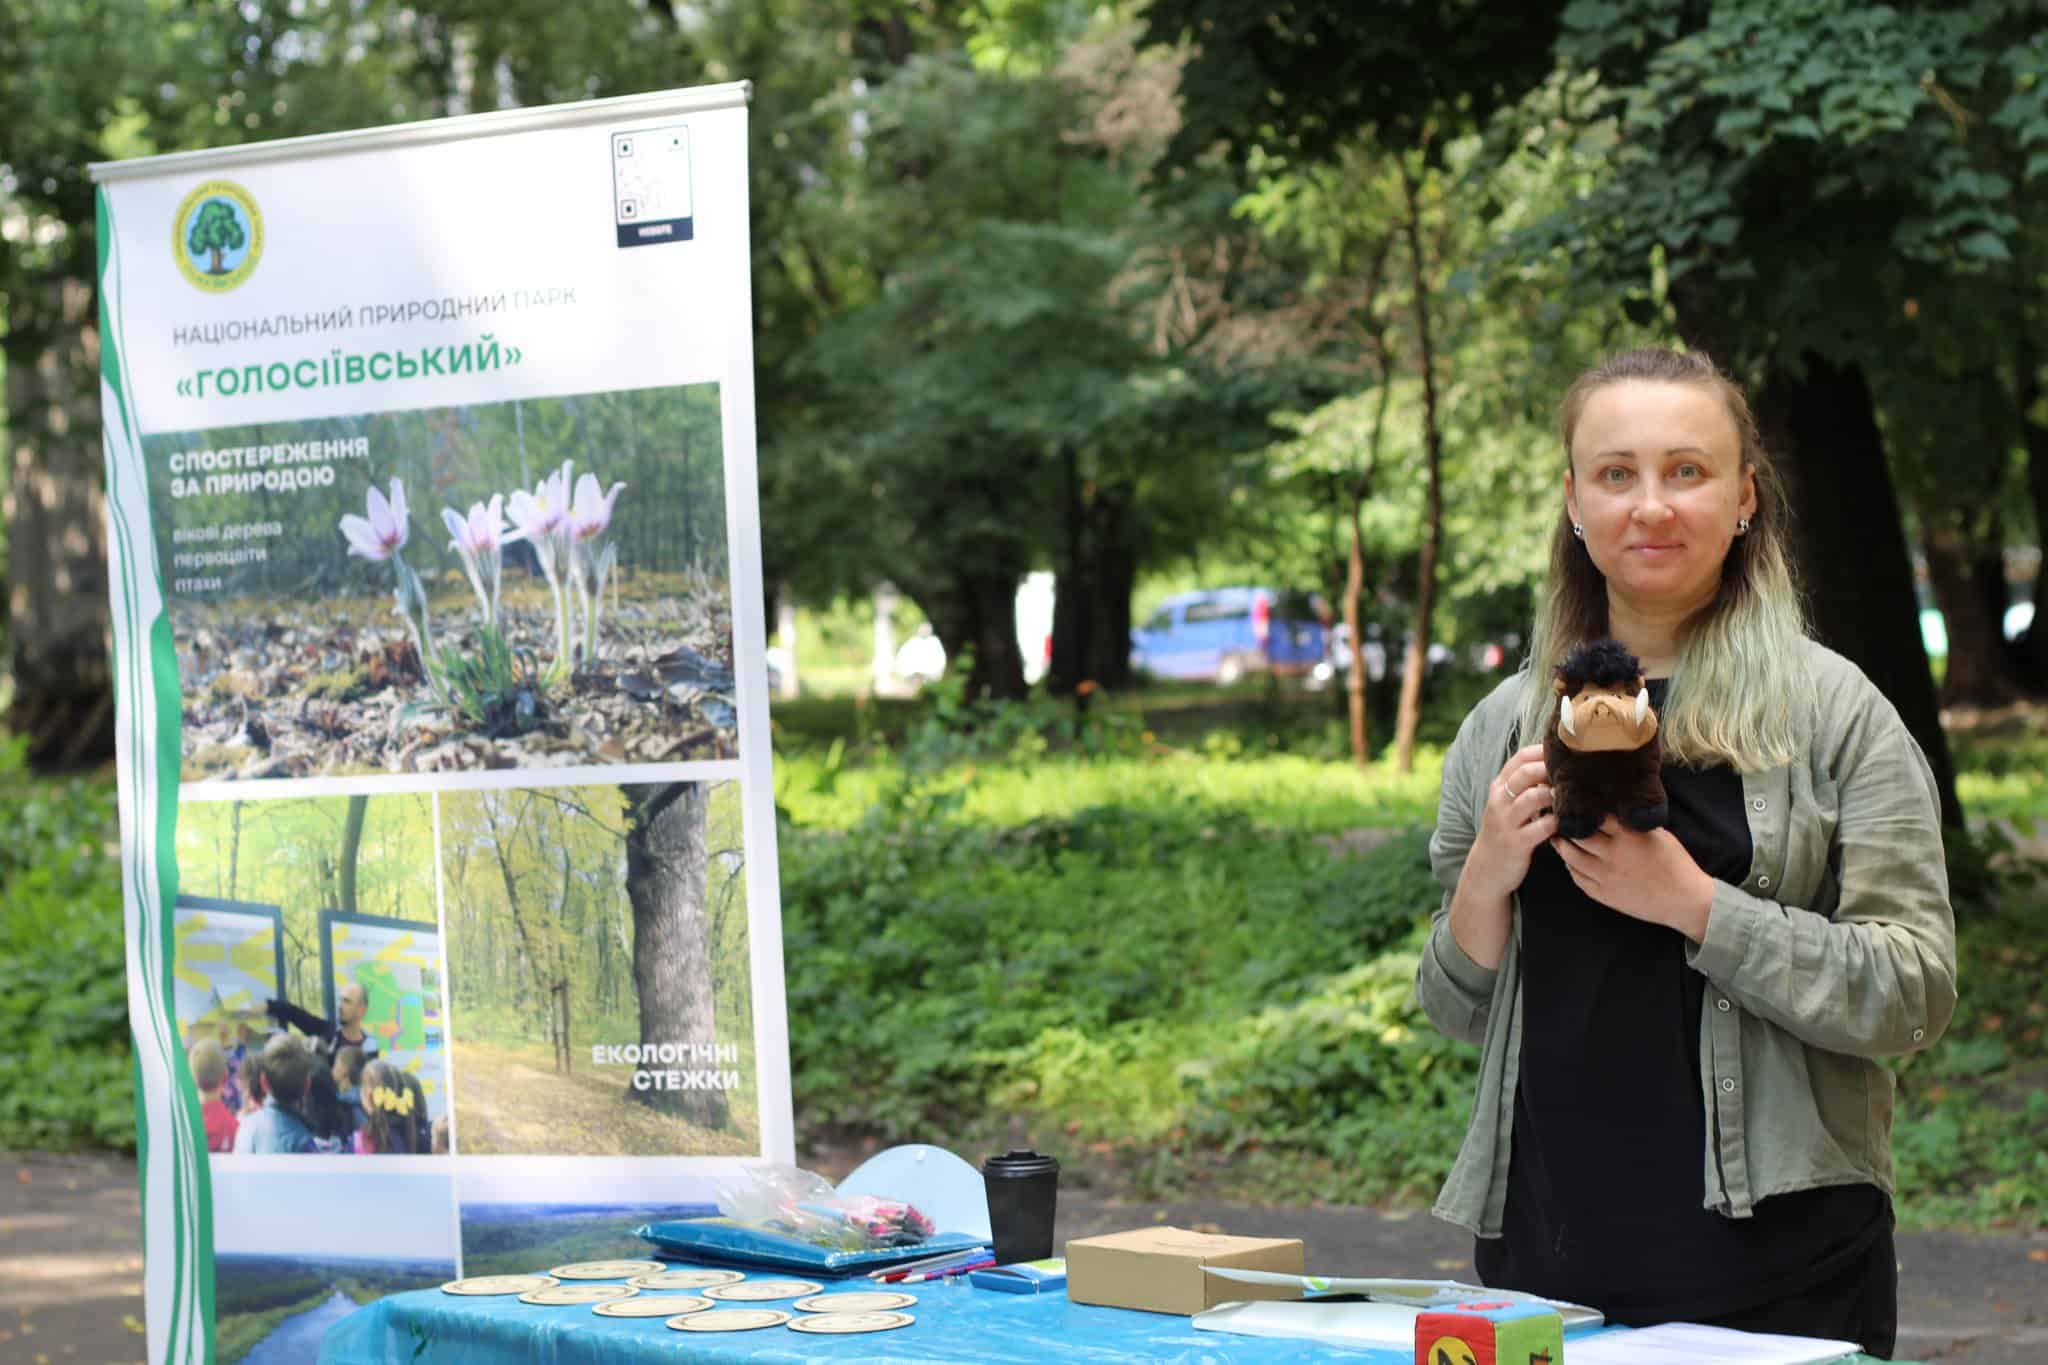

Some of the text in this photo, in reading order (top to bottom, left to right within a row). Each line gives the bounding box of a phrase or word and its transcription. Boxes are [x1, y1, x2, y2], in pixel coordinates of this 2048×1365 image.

[173, 287, 577, 346] НАЦІОНАЛЬНИЙ ПРИРОДНИЙ ПАРК
[176, 334, 523, 398] «ГОЛОСІЇВСЬКИЙ»
[169, 437, 369, 473] СПОСТЕРЕЖЕННЯ
[171, 466, 335, 498] ЗА ПРИРОДОЮ
[592, 1044, 737, 1064] ЕКОЛОГІЧНІ
[633, 1070, 739, 1090] СТЕЖКИ
